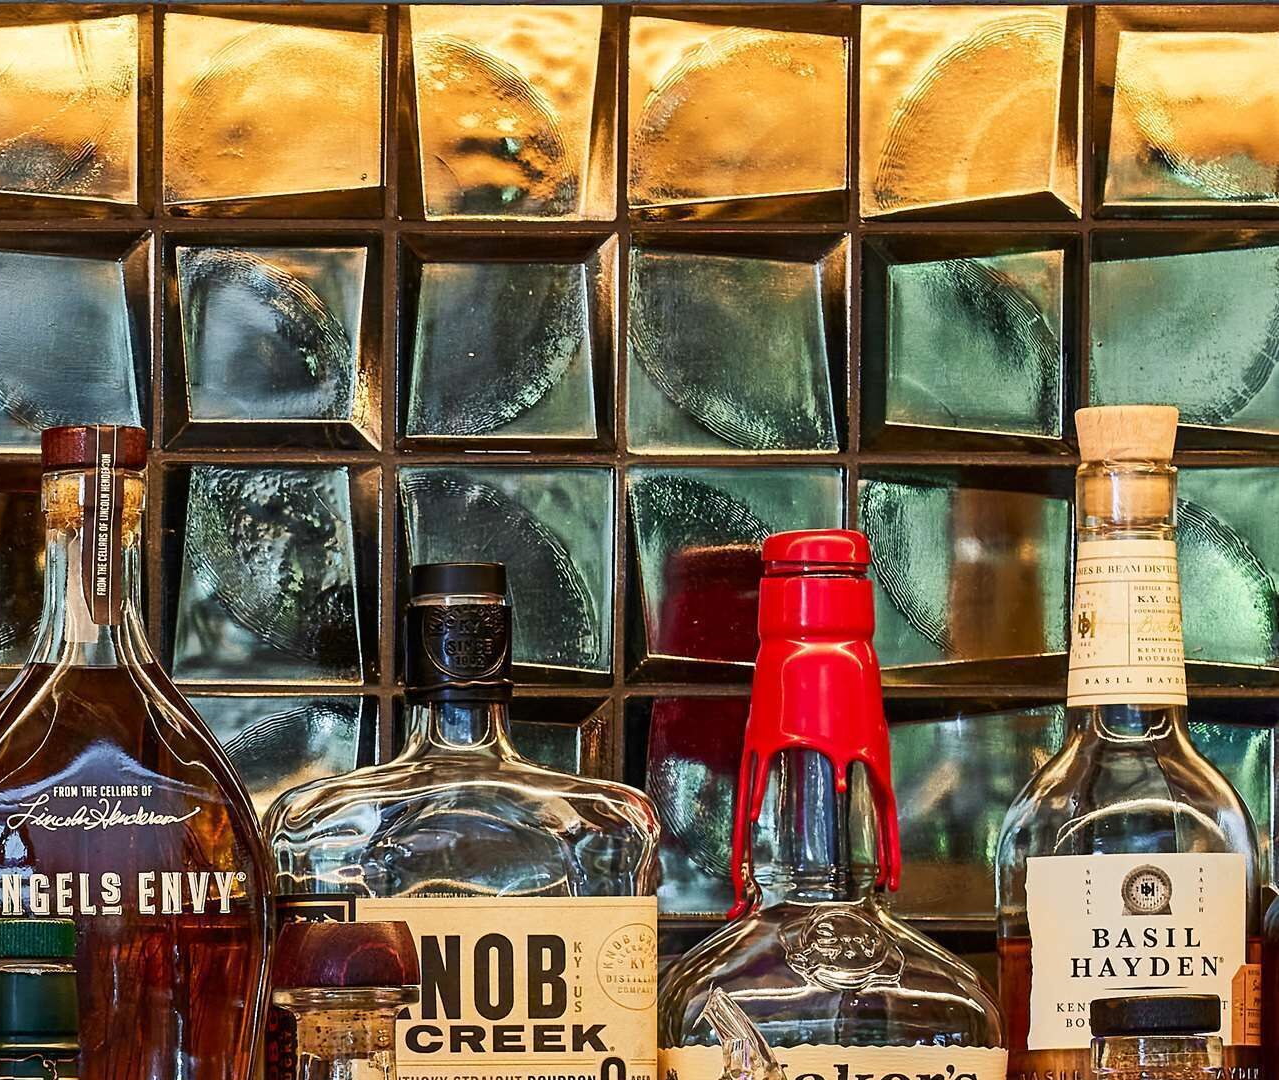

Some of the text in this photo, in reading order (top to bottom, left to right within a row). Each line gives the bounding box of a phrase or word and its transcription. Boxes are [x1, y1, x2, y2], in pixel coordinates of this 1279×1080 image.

[54, 786, 152, 797] FROM THE CELLARS OF
[138, 872, 236, 915] ENVY
[1092, 928, 1201, 948] BASIL
[397, 933, 567, 1020] NOB
[1071, 957, 1219, 978] HAYDEN
[405, 1024, 608, 1053] CREEK
